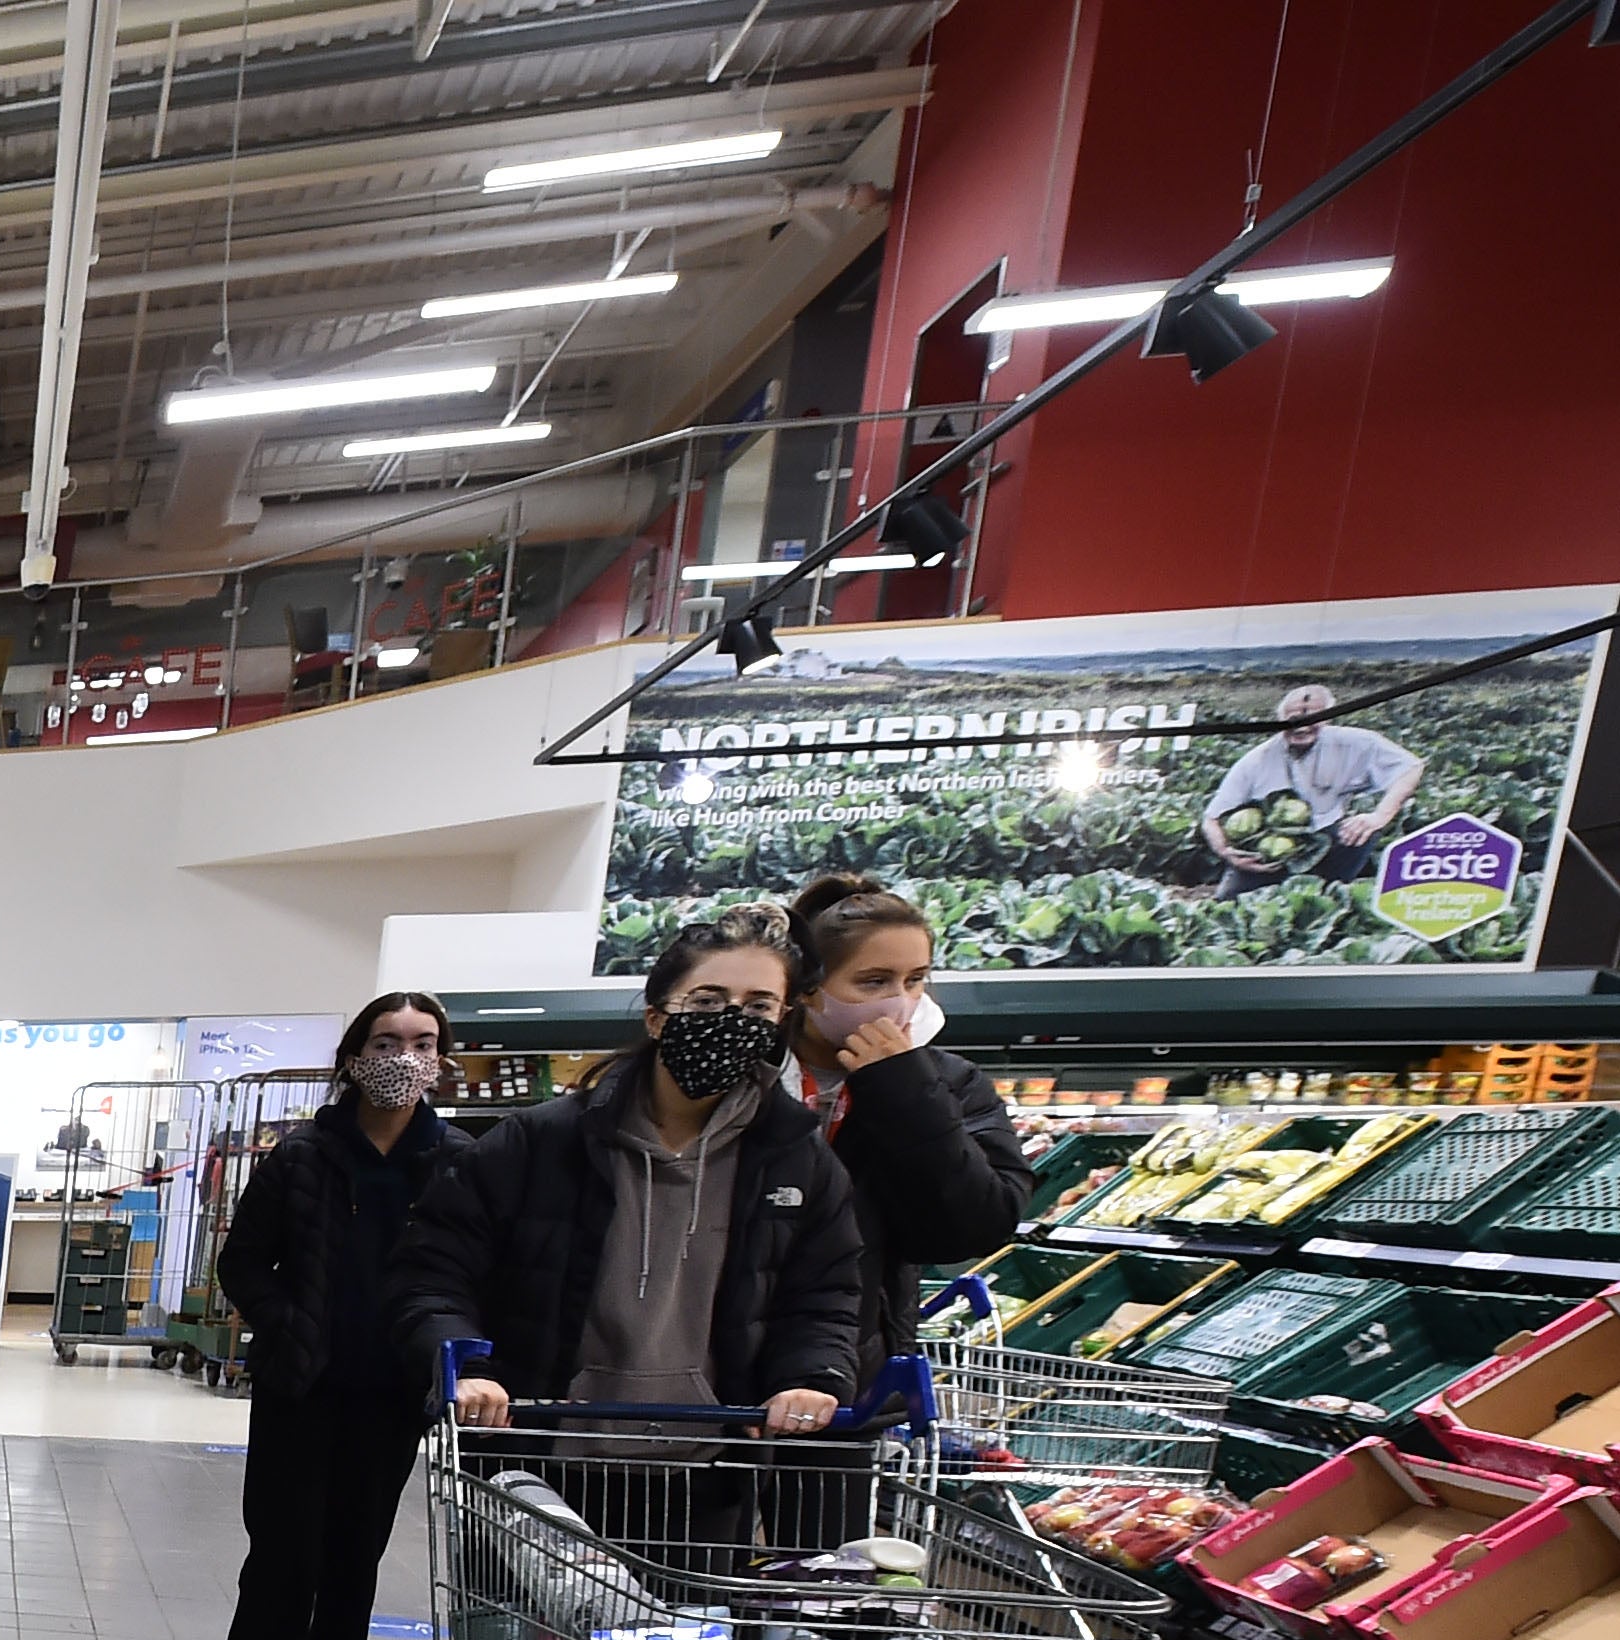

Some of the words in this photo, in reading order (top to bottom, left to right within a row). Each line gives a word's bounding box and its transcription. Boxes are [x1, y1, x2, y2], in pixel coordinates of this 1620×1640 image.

[658, 712, 1008, 773] NORTHERN
[1018, 703, 1198, 757] IRISH
[749, 779, 800, 799] with
[803, 777, 842, 796] the
[845, 776, 896, 796] best
[898, 773, 1006, 794] Northern
[650, 808, 691, 828] like
[692, 806, 754, 829] Hugh
[758, 803, 811, 823] from
[816, 801, 909, 823] Comber
[1424, 831, 1488, 846] TESCO
[1400, 849, 1501, 881] taste
[1397, 889, 1488, 906] Northern
[1406, 903, 1473, 921] Ireland
[24, 1025, 79, 1049] you
[88, 1023, 126, 1048] go
